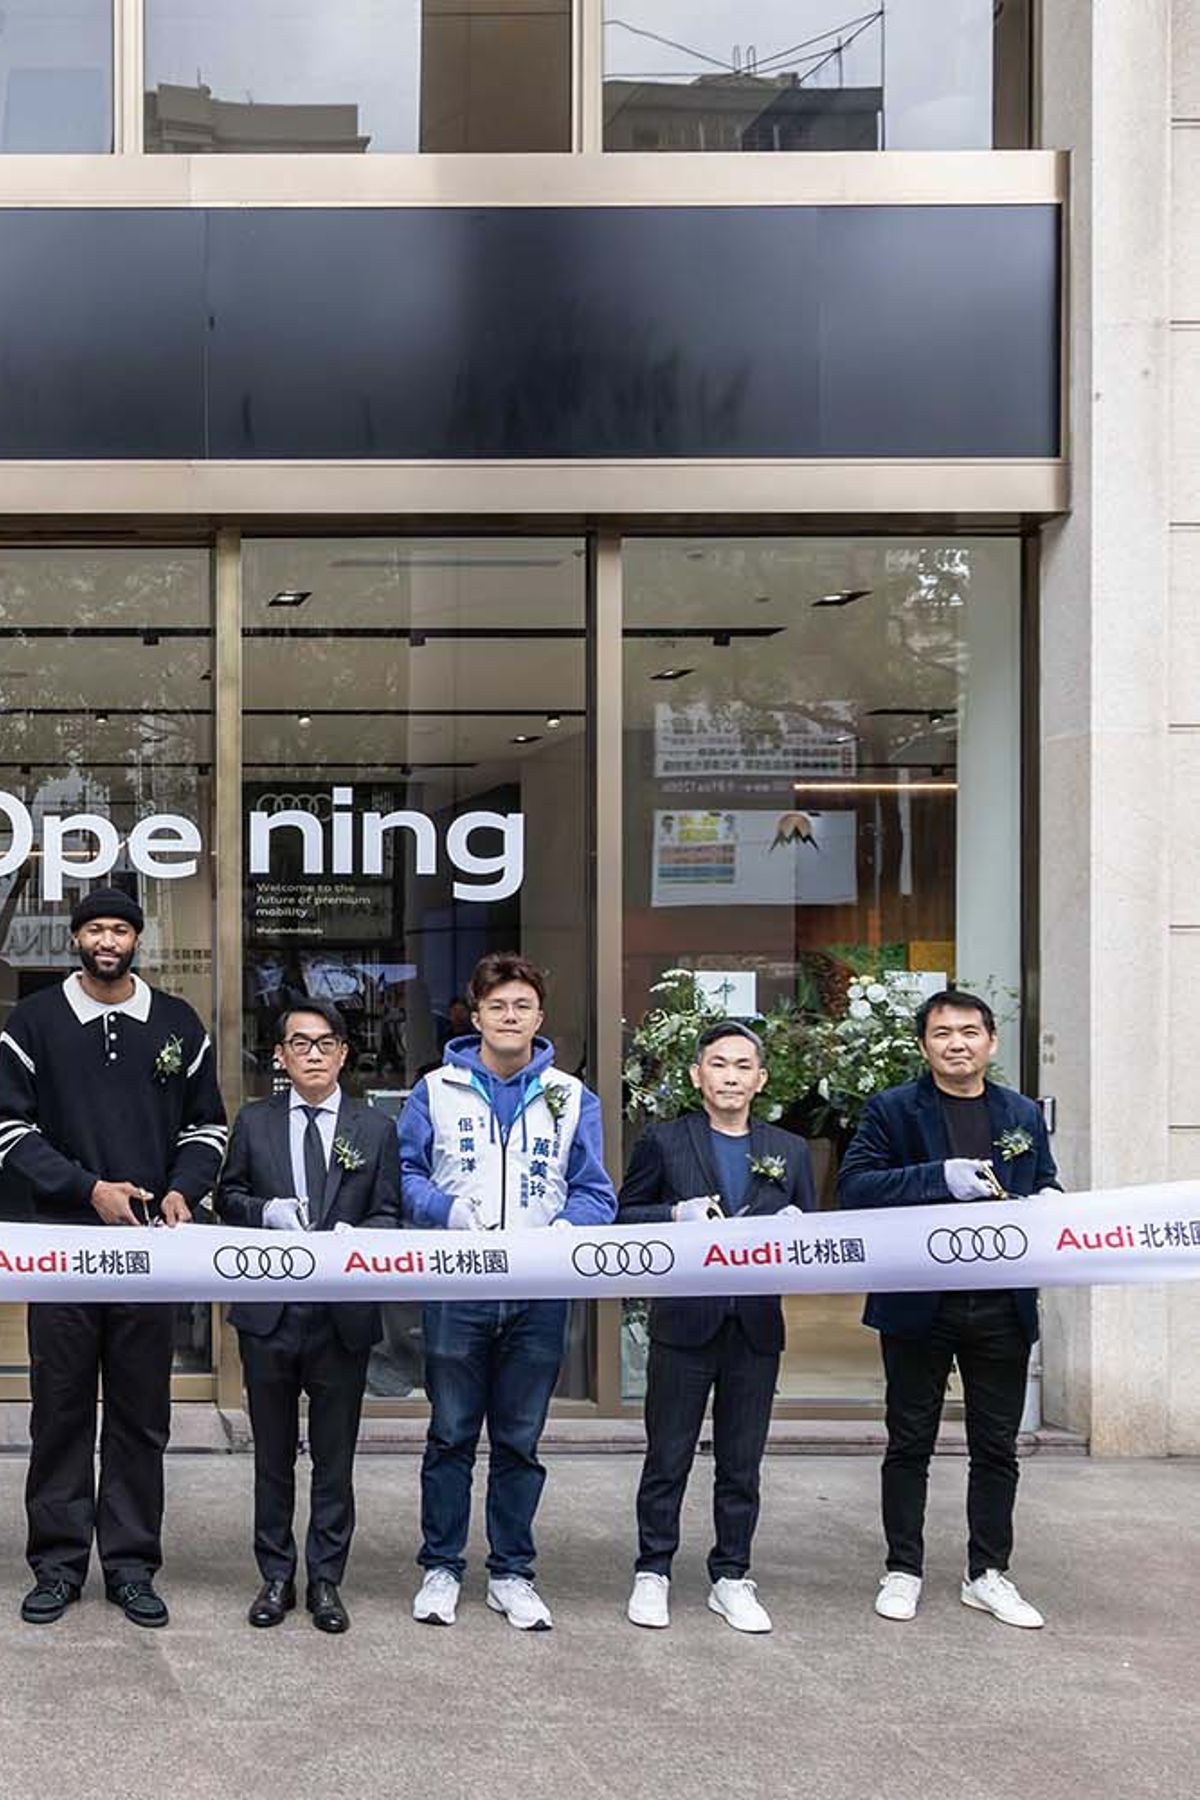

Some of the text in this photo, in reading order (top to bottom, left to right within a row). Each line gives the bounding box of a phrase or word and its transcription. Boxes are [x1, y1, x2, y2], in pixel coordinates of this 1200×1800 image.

[256, 883, 314, 893] Welcome
[318, 883, 332, 893] to
[256, 895, 371, 906] future of premium
[256, 907, 308, 918] mobility
